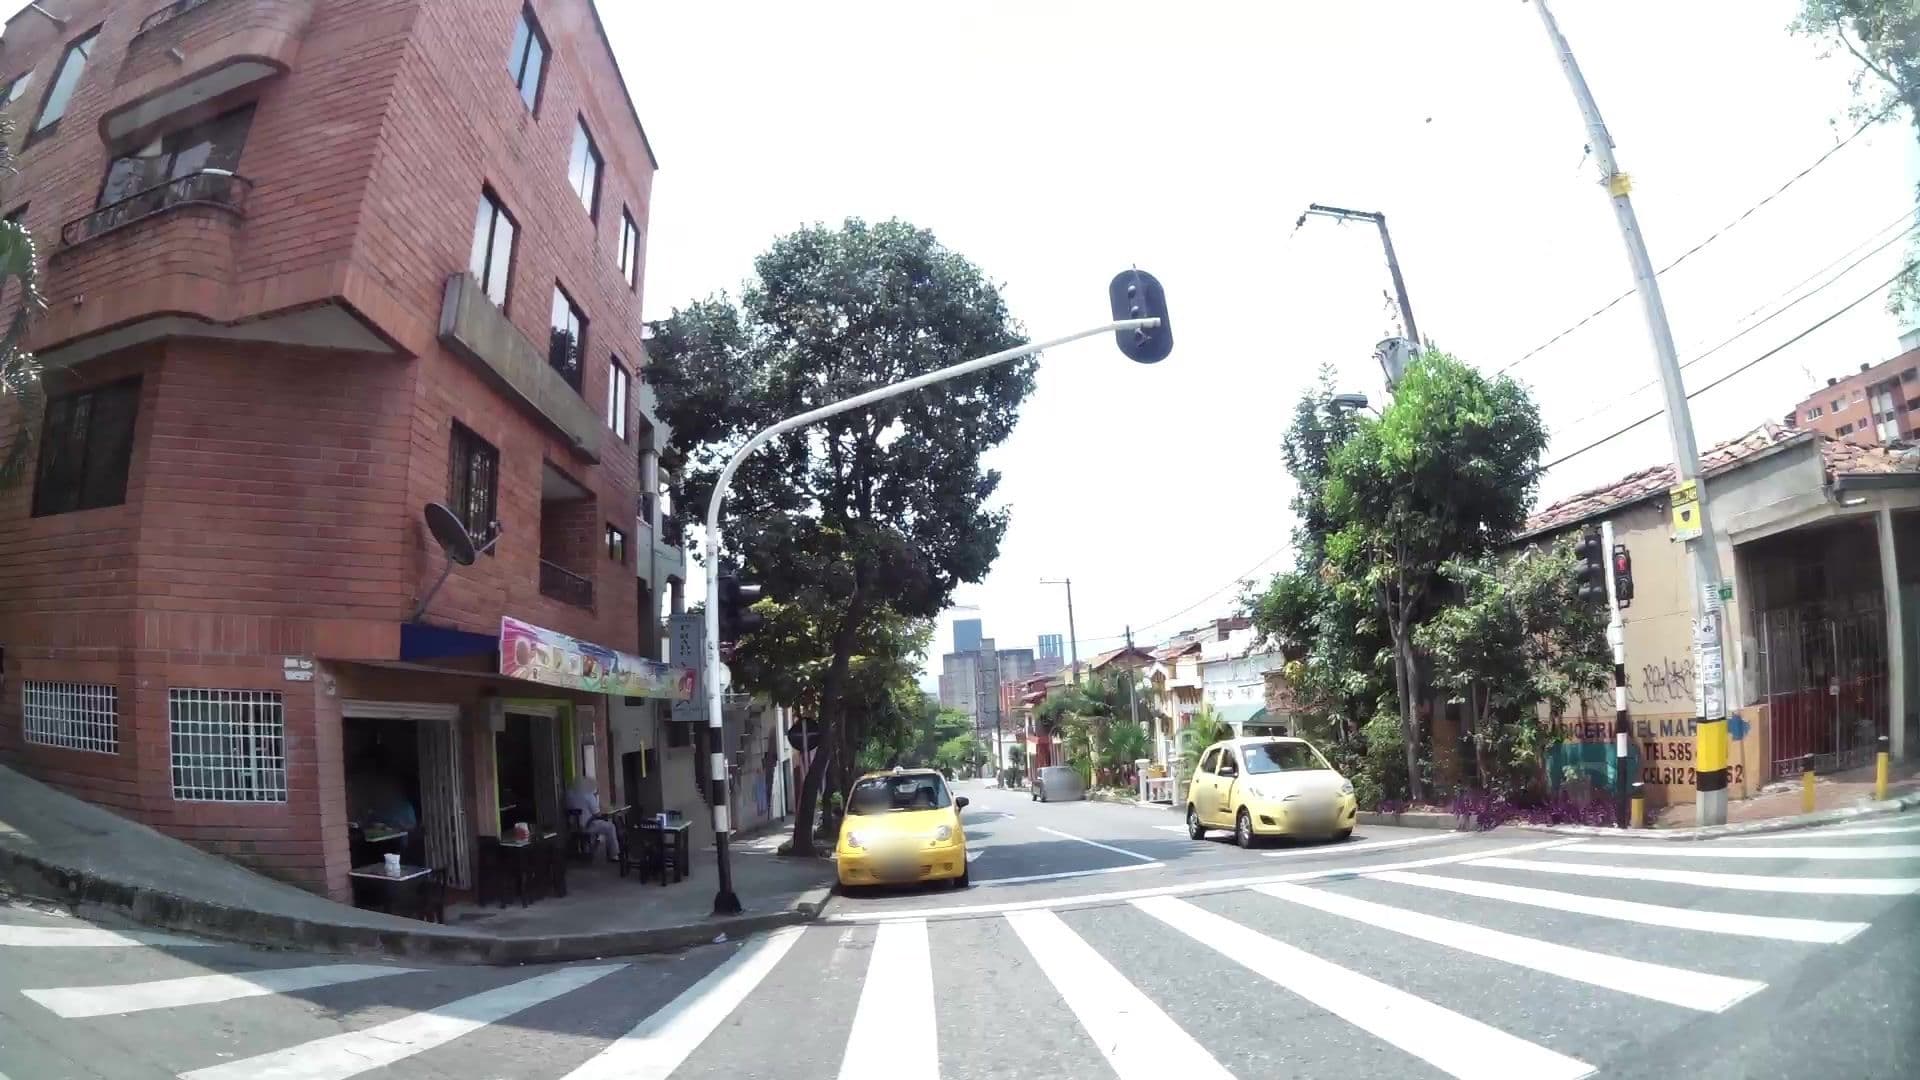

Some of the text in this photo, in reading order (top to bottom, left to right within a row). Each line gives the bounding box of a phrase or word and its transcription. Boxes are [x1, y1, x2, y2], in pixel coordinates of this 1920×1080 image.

[1644, 742, 1692, 761] TEL 585
[1664, 767, 1685, 785] 312
